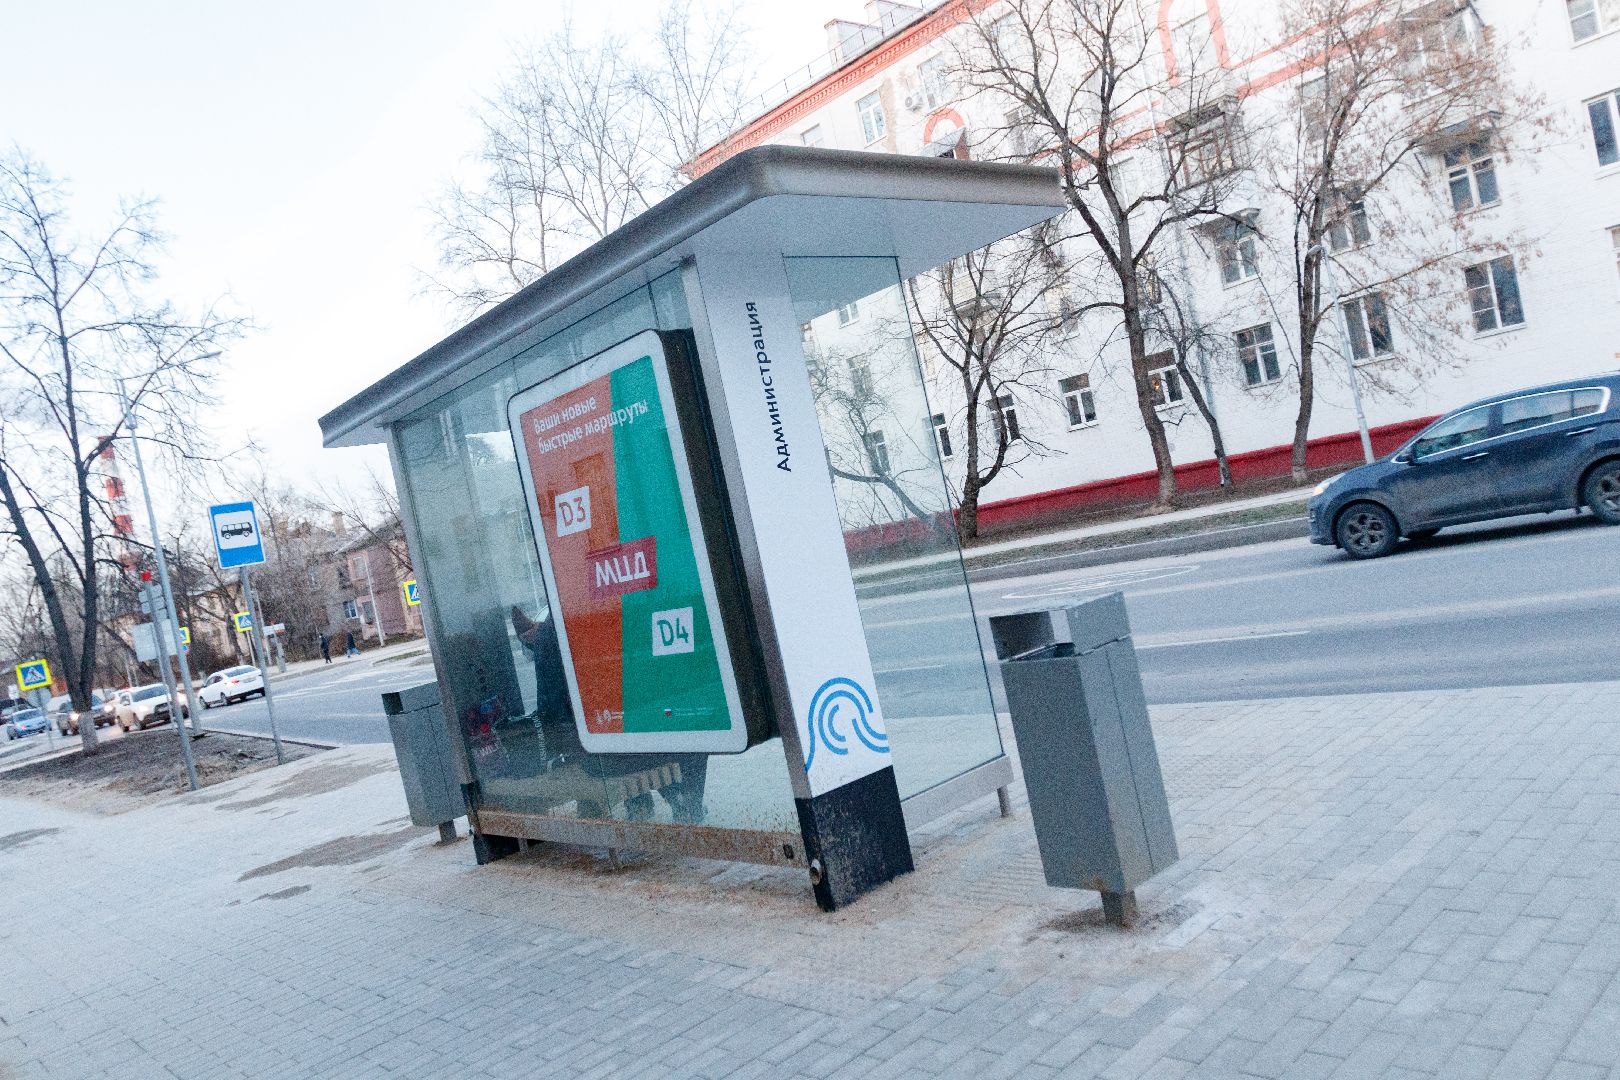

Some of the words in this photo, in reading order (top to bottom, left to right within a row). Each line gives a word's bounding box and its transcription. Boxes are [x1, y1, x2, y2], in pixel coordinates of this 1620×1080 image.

[745, 301, 792, 473] Администрация
[533, 412, 561, 435] Ваши
[561, 396, 597, 422] новые
[538, 426, 583, 455] быстрые
[584, 399, 649, 436] маршруты
[558, 496, 587, 527] D3
[595, 550, 651, 588] МЦД
[656, 617, 689, 647] D4
